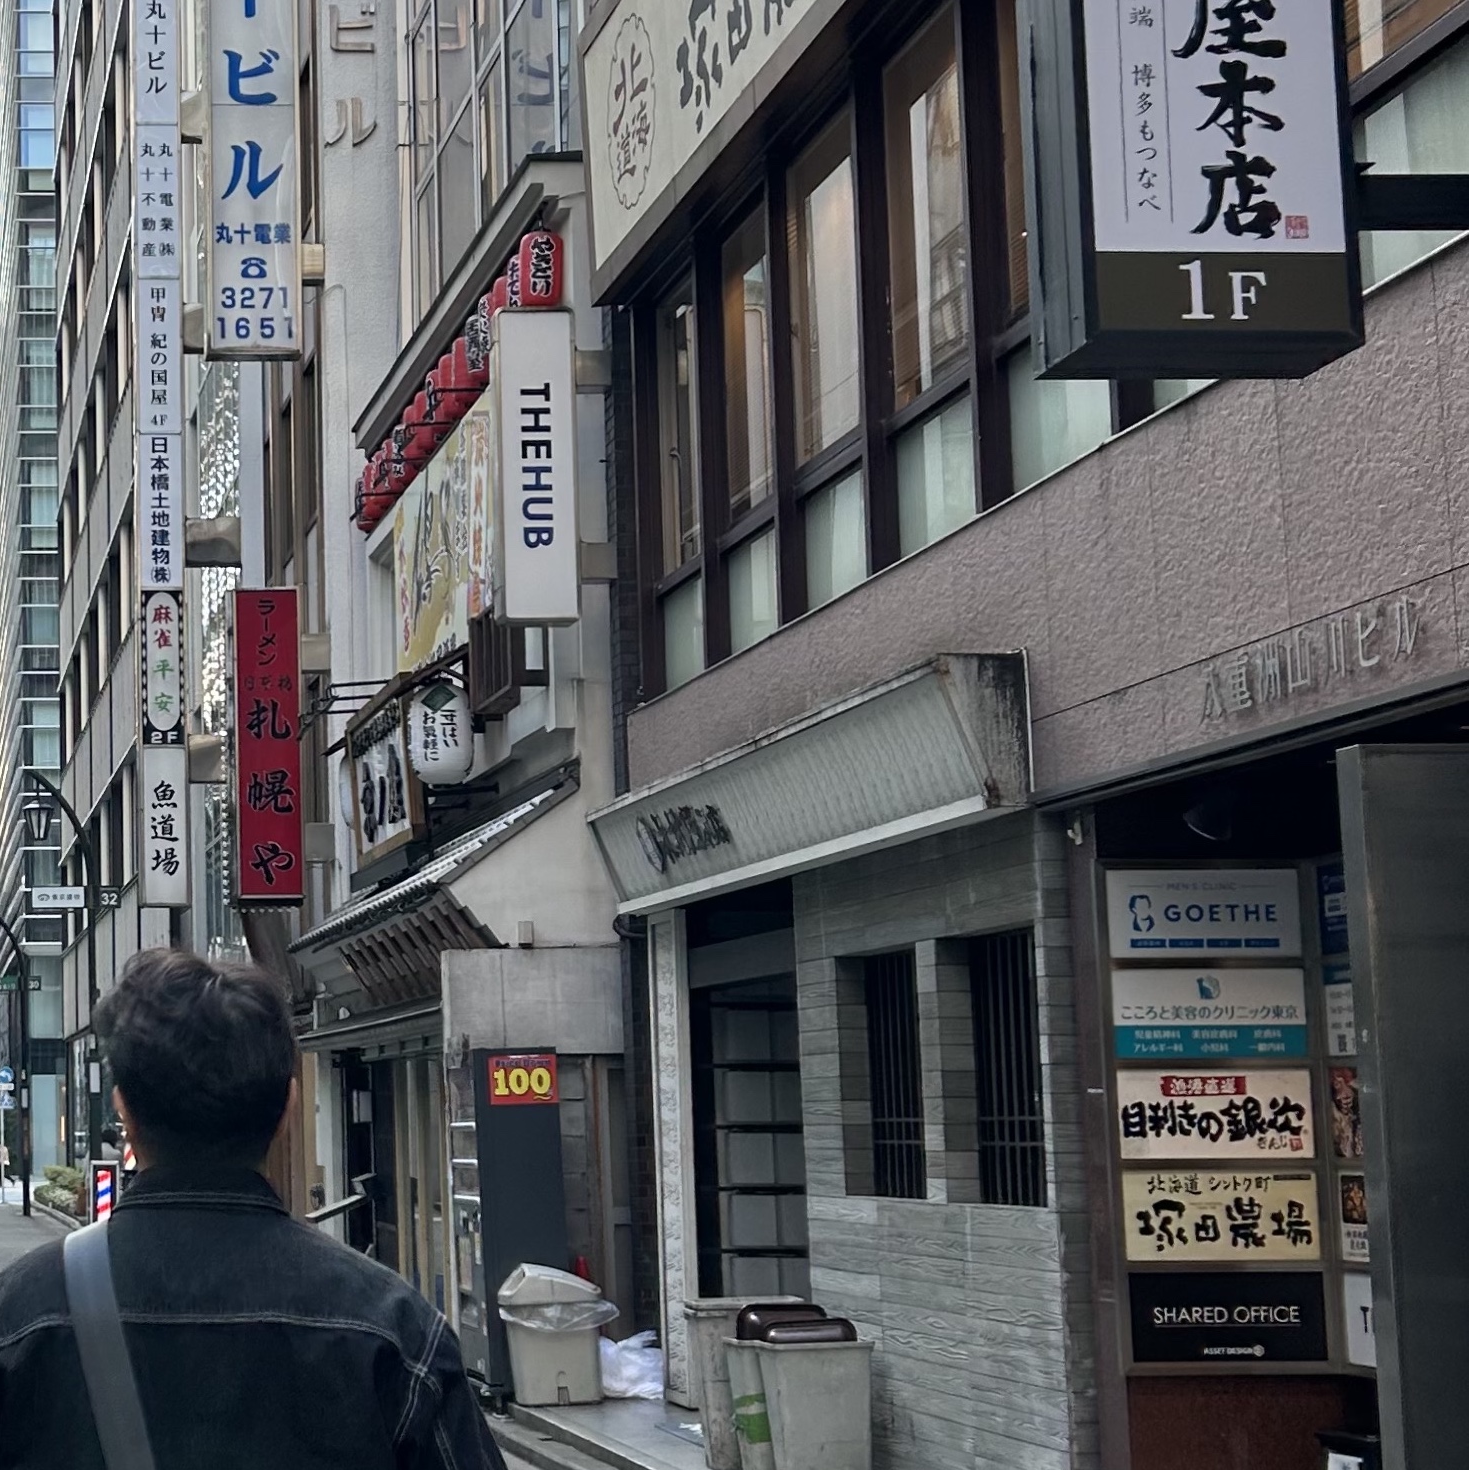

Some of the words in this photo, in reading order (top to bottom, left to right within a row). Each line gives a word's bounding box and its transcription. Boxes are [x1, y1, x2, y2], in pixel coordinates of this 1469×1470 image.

[222, 0, 284, 200] ビル
[612, 42, 651, 184] 北海道
[1131, 63, 1162, 211] 博多もつなべ
[140, 142, 157, 257] 丸十不動産
[216, 222, 292, 245] 丸十電業
[150, 287, 167, 323] 甲冑
[221, 287, 289, 310] 3271
[1178, 259, 1267, 320] 1F
[217, 317, 294, 339] 1651
[150, 332, 168, 406] 紀の国屋
[150, 413, 168, 427] 4F
[151, 604, 173, 649] 麻雀
[257, 599, 276, 666] ラーメン
[153, 659, 175, 714] 平安
[150, 732, 178, 744] 2F
[245, 699, 296, 886] 札幌や
[150, 779, 180, 877] 魚道場
[101, 892, 118, 906] 32
[1164, 904, 1279, 923] GOETHE
[1121, 1004, 1299, 1021] こころと美容のクリニック東京
[493, 1067, 551, 1096] 100
[1121, 1096, 1306, 1142] 目利きの銀次
[1146, 1173, 1202, 1196] 北海道
[1136, 1196, 1314, 1252] 塚田農場
[1153, 1306, 1228, 1325] SHARED
[1233, 1305, 1301, 1323] OFFICE
[1204, 1347, 1225, 1355] ASSET
